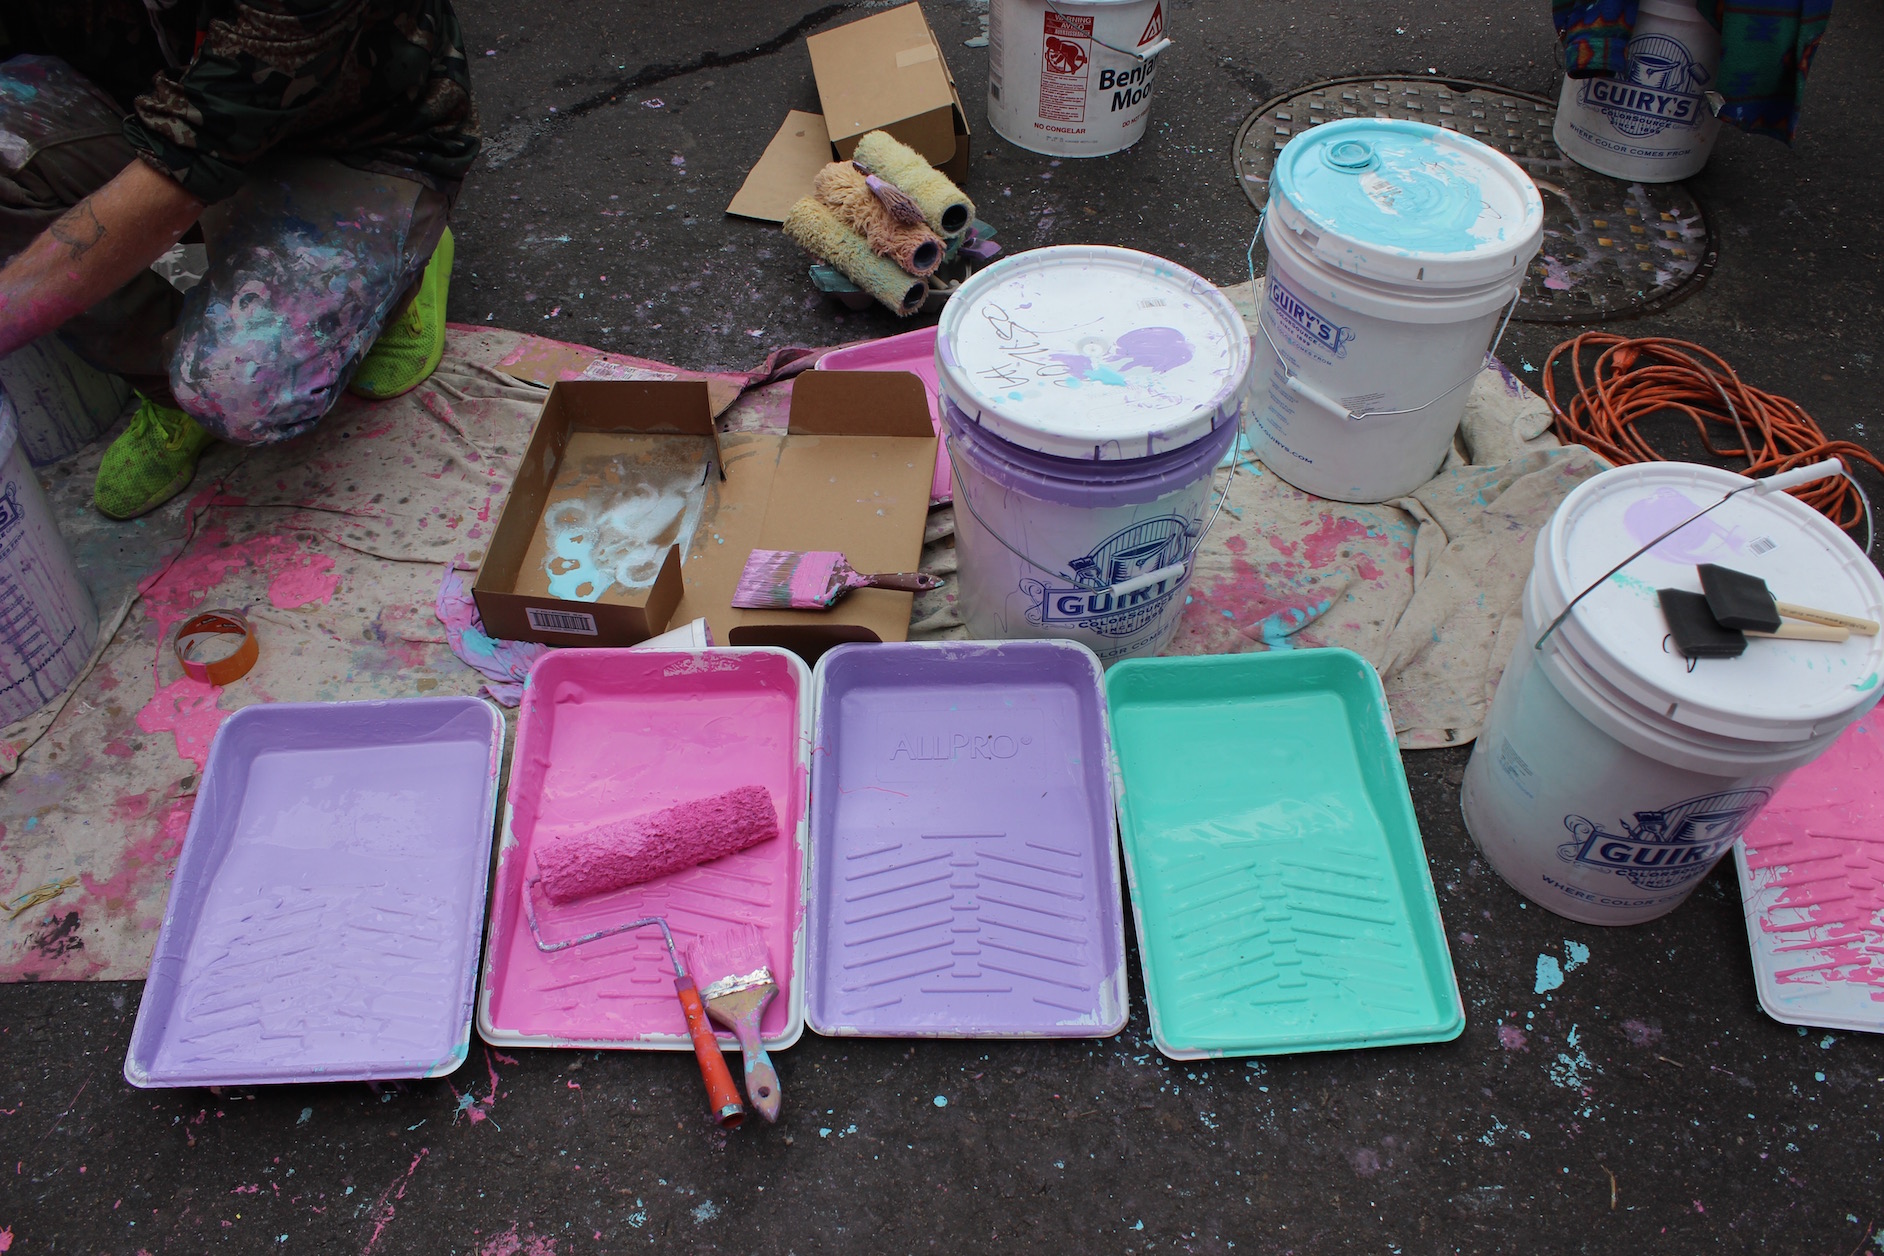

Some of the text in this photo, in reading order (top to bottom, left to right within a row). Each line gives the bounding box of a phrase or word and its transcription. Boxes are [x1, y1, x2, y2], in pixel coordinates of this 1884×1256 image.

[1054, 14, 1092, 24] WRNING
[1593, 81, 1693, 118] GUIRY'S
[1034, 122, 1086, 134] NO CONGELAR
[1601, 108, 1672, 129] COLORSOURCE
[1610, 117, 1635, 130] SINCE
[1569, 122, 1593, 142] WHERE
[1595, 138, 1627, 153] COLOR
[1630, 148, 1664, 157] COMES
[1273, 284, 1332, 340] GUIRY'S
[1276, 308, 1318, 345] COLORSOURCE
[0, 625, 76, 695] WW.GUIRYS.COM
[1096, 647, 1127, 658] LOR
[1543, 875, 1653, 906] WHERE COLOR
